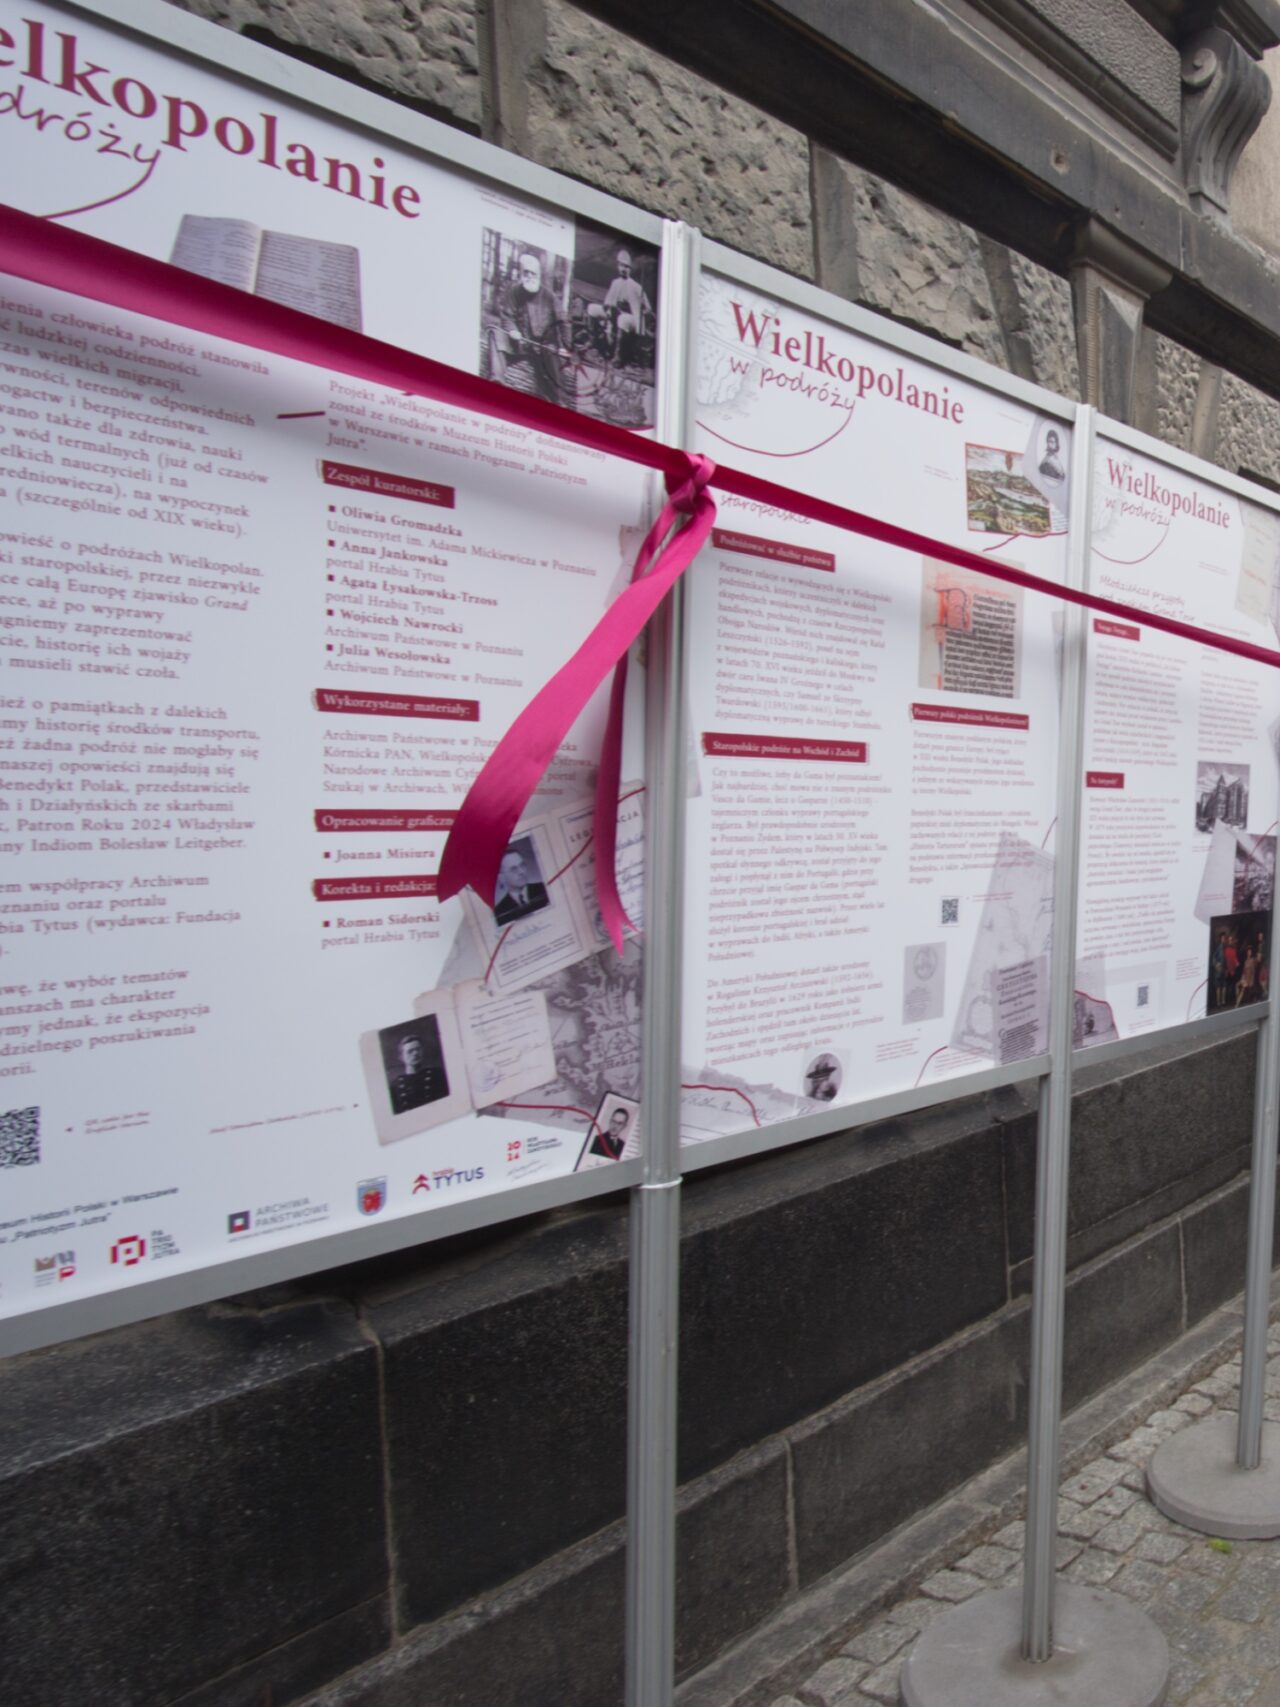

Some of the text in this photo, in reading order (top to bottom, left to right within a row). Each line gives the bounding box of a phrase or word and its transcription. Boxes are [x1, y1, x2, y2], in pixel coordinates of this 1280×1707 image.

[18, 322, 88, 351] ludzkiej
[50, 310, 195, 356] człowieka podróż
[37, 348, 110, 375] wielkich
[729, 300, 965, 423] Wielkopolanie
[329, 380, 375, 402] Projekt
[729, 356, 855, 411] w podróży
[77, 377, 255, 427] terenów odpowiednich
[82, 397, 209, 435] bezpieczeństwa.
[329, 401, 438, 433] został środków
[46, 411, 243, 461] także zdrowia, nauki
[344, 419, 525, 471] Warszawie ramach Programu
[57, 434, 268, 484] termalnych (już czasów
[61, 455, 151, 482] nauczycieli
[327, 467, 440, 501] Zespół kuratorski:
[1107, 457, 1230, 528] Wielkopolanie
[16, 486, 247, 539] (szczególnie wieku).
[157, 492, 250, 518] wypoczynek
[342, 506, 463, 536] Oliwia Gromadzka
[77, 540, 264, 578] podróżach Wielkopolan.
[327, 520, 596, 577] Uniwersytet Adama Mickiewicza Poznaniu
[340, 541, 448, 566] Anna Jankowska
[326, 558, 445, 582] portal Hrabia Tytus
[26, 574, 248, 611] całą Europę zjawisko Grand
[139, 570, 261, 595] przez niezwykle
[341, 576, 377, 590] Agata
[92, 603, 164, 623] wyprawy
[340, 609, 463, 634] Wojciech Nawrocki
[75, 621, 193, 643] zaprezentować
[324, 626, 457, 650] Archiwum Państwowe
[35, 635, 191, 664] historię wojaży
[337, 644, 451, 664] Julia Wesołowska
[9, 656, 180, 680] musieli stawić czoła.
[50, 700, 227, 720] pamiątkach dalekich
[323, 693, 411, 712] Wykorzystane
[35, 717, 261, 740] historię środków transportu.
[23, 739, 234, 759] żadna podróż mogłaby
[59, 760, 210, 777] opowieści znajdują
[391, 766, 452, 779] Archiwum
[81, 779, 250, 795] Polak, przedstawiciele
[30, 799, 234, 815] Działyńskich skarbami
[17, 819, 255, 833] Patron Roku 2024 Władysław
[321, 815, 404, 829] Opracowanie
[31, 838, 168, 852] Indiom Bolesław
[335, 848, 435, 863] Joanna Misiura
[29, 876, 209, 894] współpracy Archiwum
[321, 880, 436, 895] Korekta redakcja:
[66, 895, 166, 911] oraz portalu
[31, 910, 241, 935] Tytus (wydawca: Fundacja
[337, 912, 440, 929] Roman Sidorski
[64, 969, 189, 992] wybór tematów
[101, 989, 176, 1005] charakter
[38, 1004, 210, 1035] jednak, ekspozycja
[90, 1024, 196, 1049] poszukiwania
[433, 1167, 484, 1189] TYTUS
